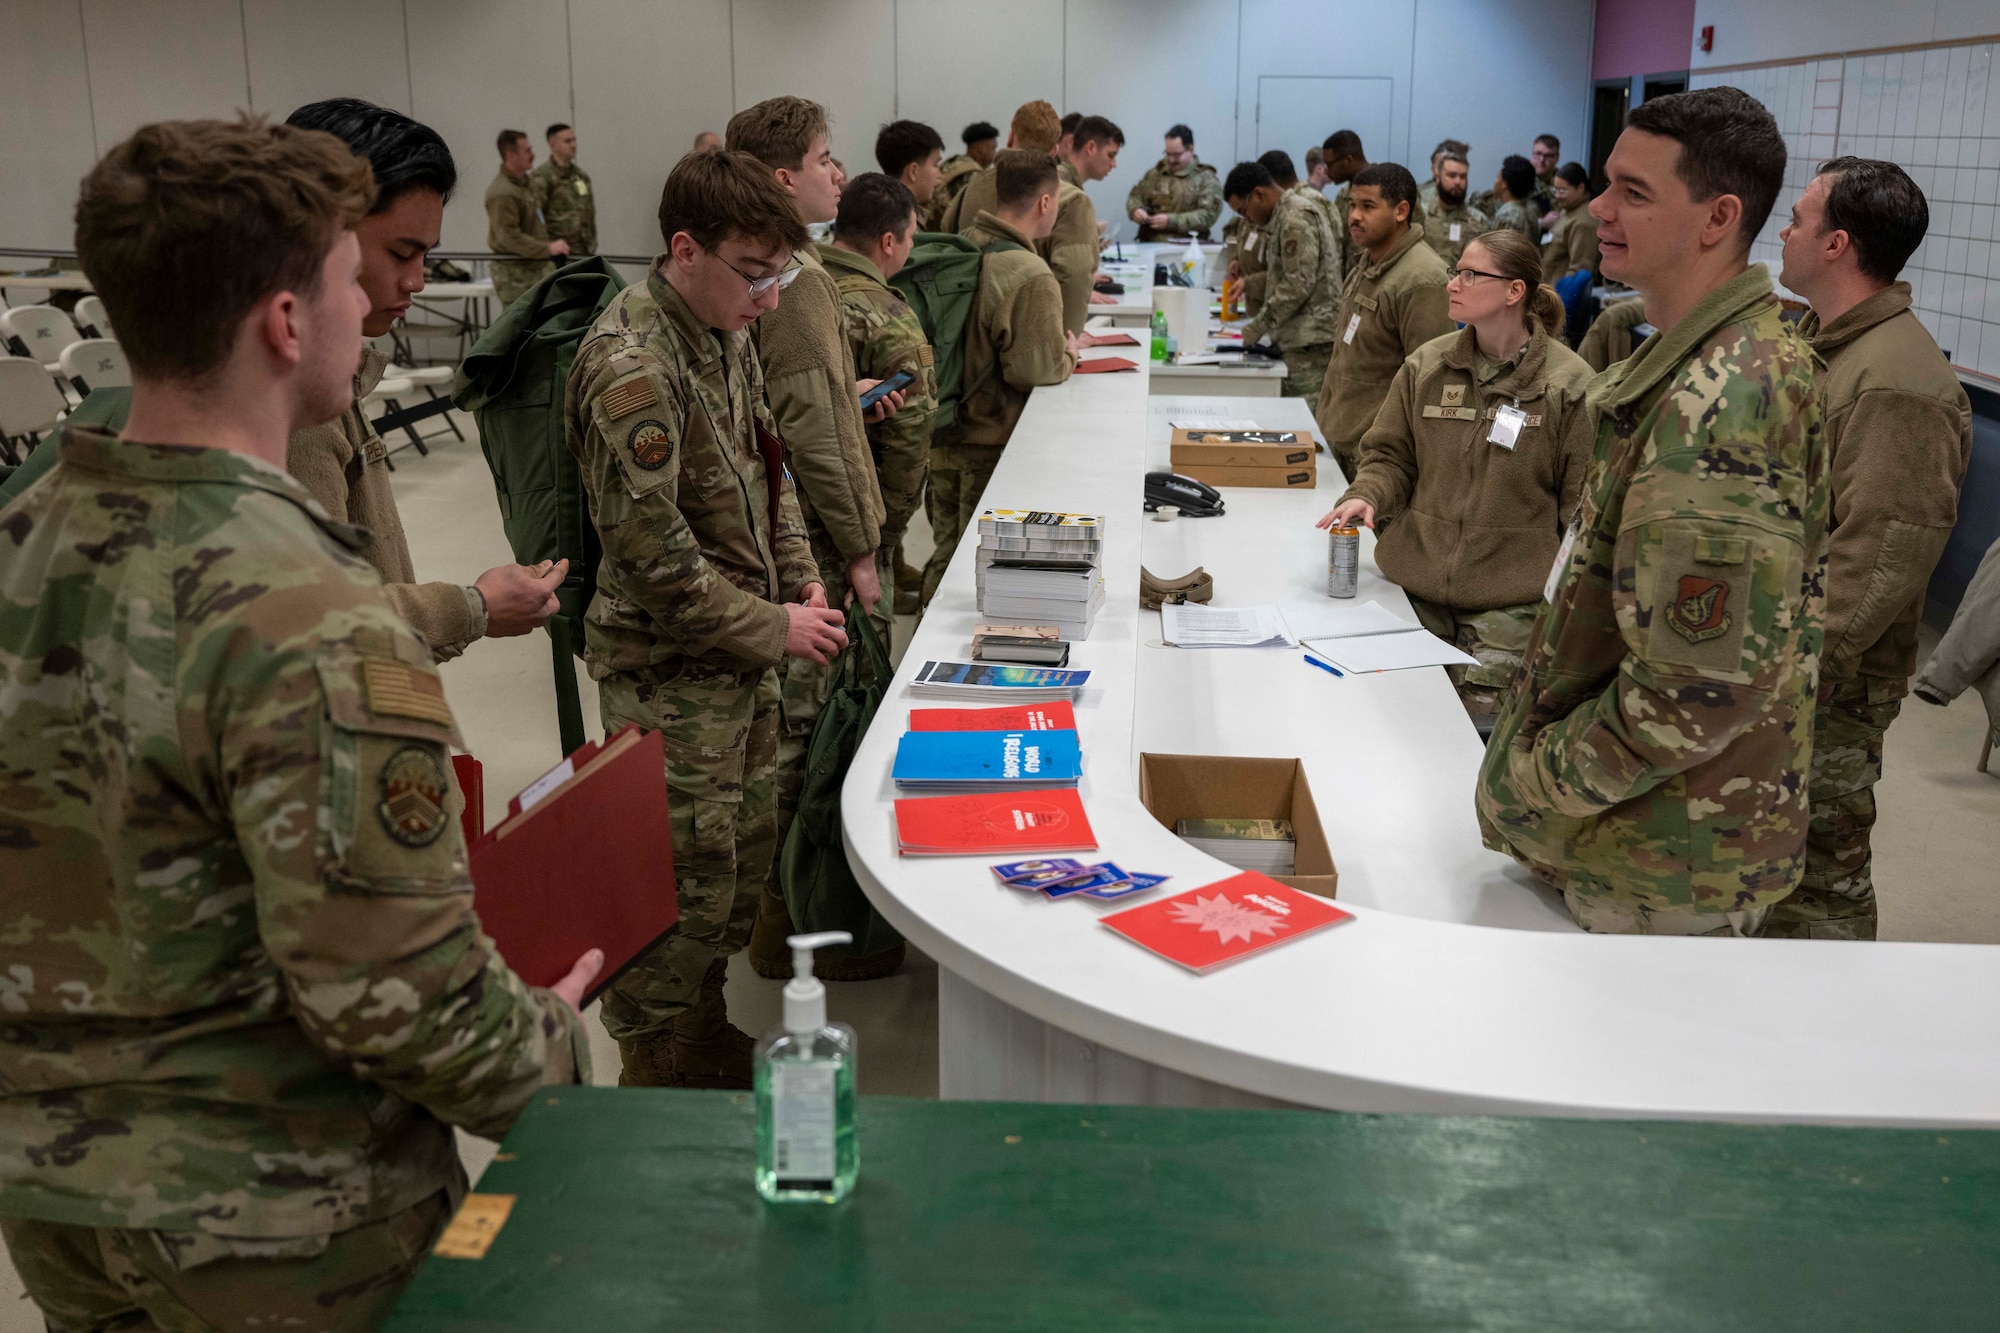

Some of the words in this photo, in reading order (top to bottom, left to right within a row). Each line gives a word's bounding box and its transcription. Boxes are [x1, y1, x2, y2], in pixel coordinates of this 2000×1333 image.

[1441, 408, 1458, 418] KIRK
[1002, 738, 1021, 778] RELIGIONS
[1023, 746, 1041, 773] WORLD
